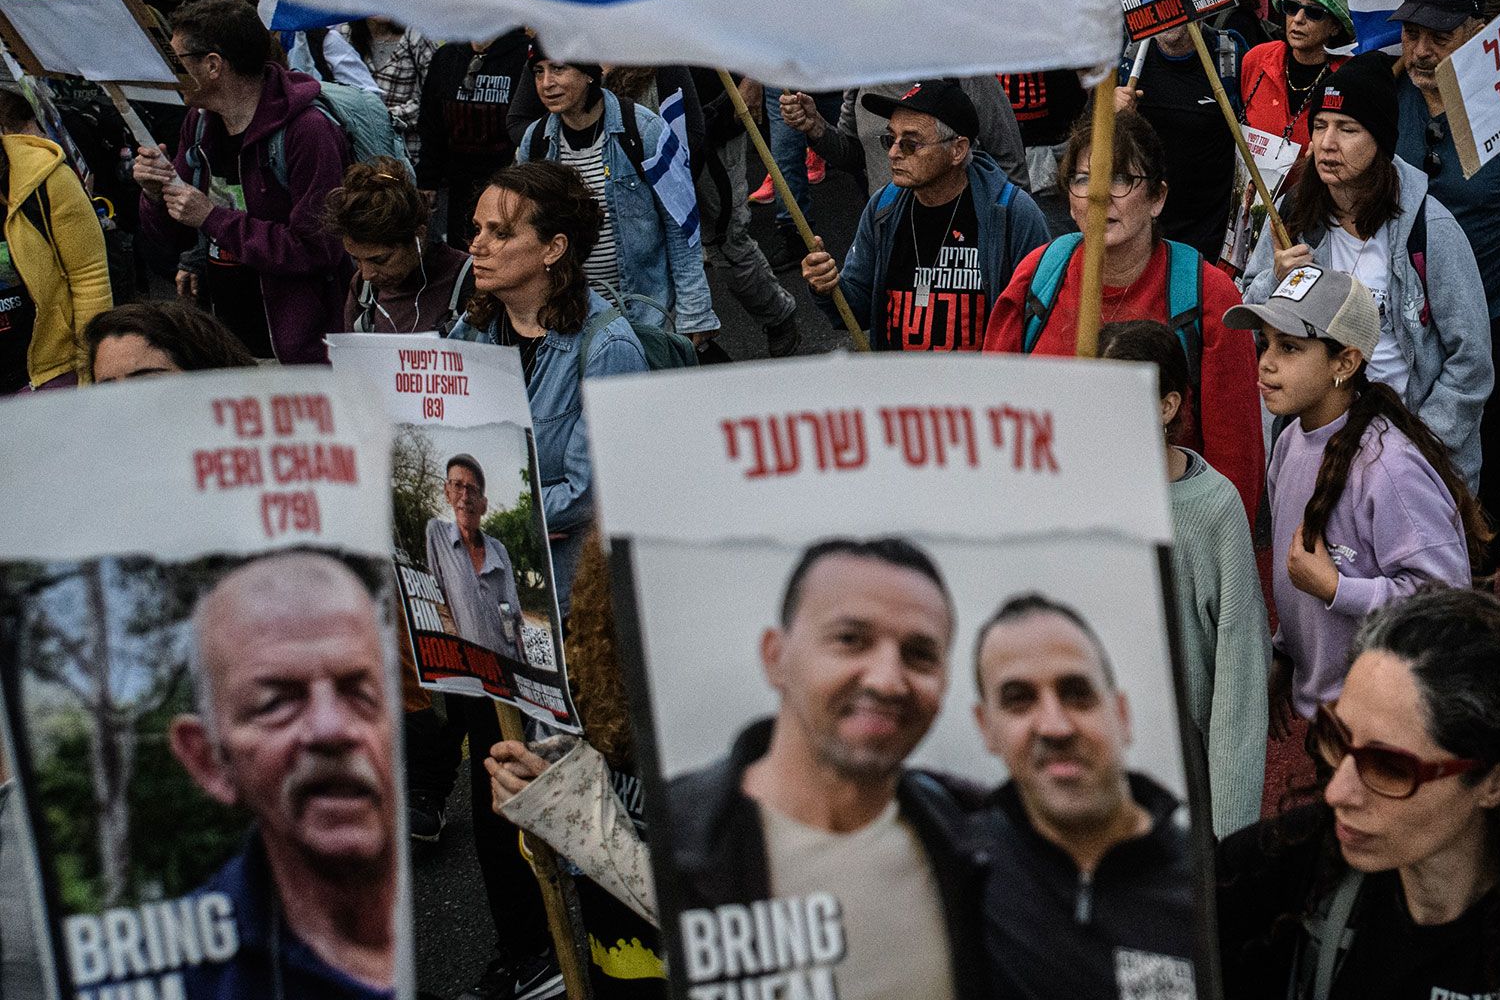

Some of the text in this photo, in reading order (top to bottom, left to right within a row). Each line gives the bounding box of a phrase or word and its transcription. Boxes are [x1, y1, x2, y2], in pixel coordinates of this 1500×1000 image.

[1126, 6, 1158, 32] HOME
[940, 246, 980, 268] חזירים
[0, 296, 22, 312] OSES
[399, 349, 463, 372] עודד ליפשיץ
[395, 373, 470, 396] ODED LIFSHITZ
[211, 392, 335, 439] חיים פרי
[422, 396, 445, 420] (83)
[719, 401, 1061, 480] אלי ויוסי שרעבי
[193, 446, 264, 493] PERI
[260, 487, 321, 538] (79)
[400, 566, 446, 604] BRING
[409, 598, 444, 632] HIM
[418, 636, 467, 670] HOME
[63, 892, 240, 985] BRING
[679, 892, 846, 982] BRING
